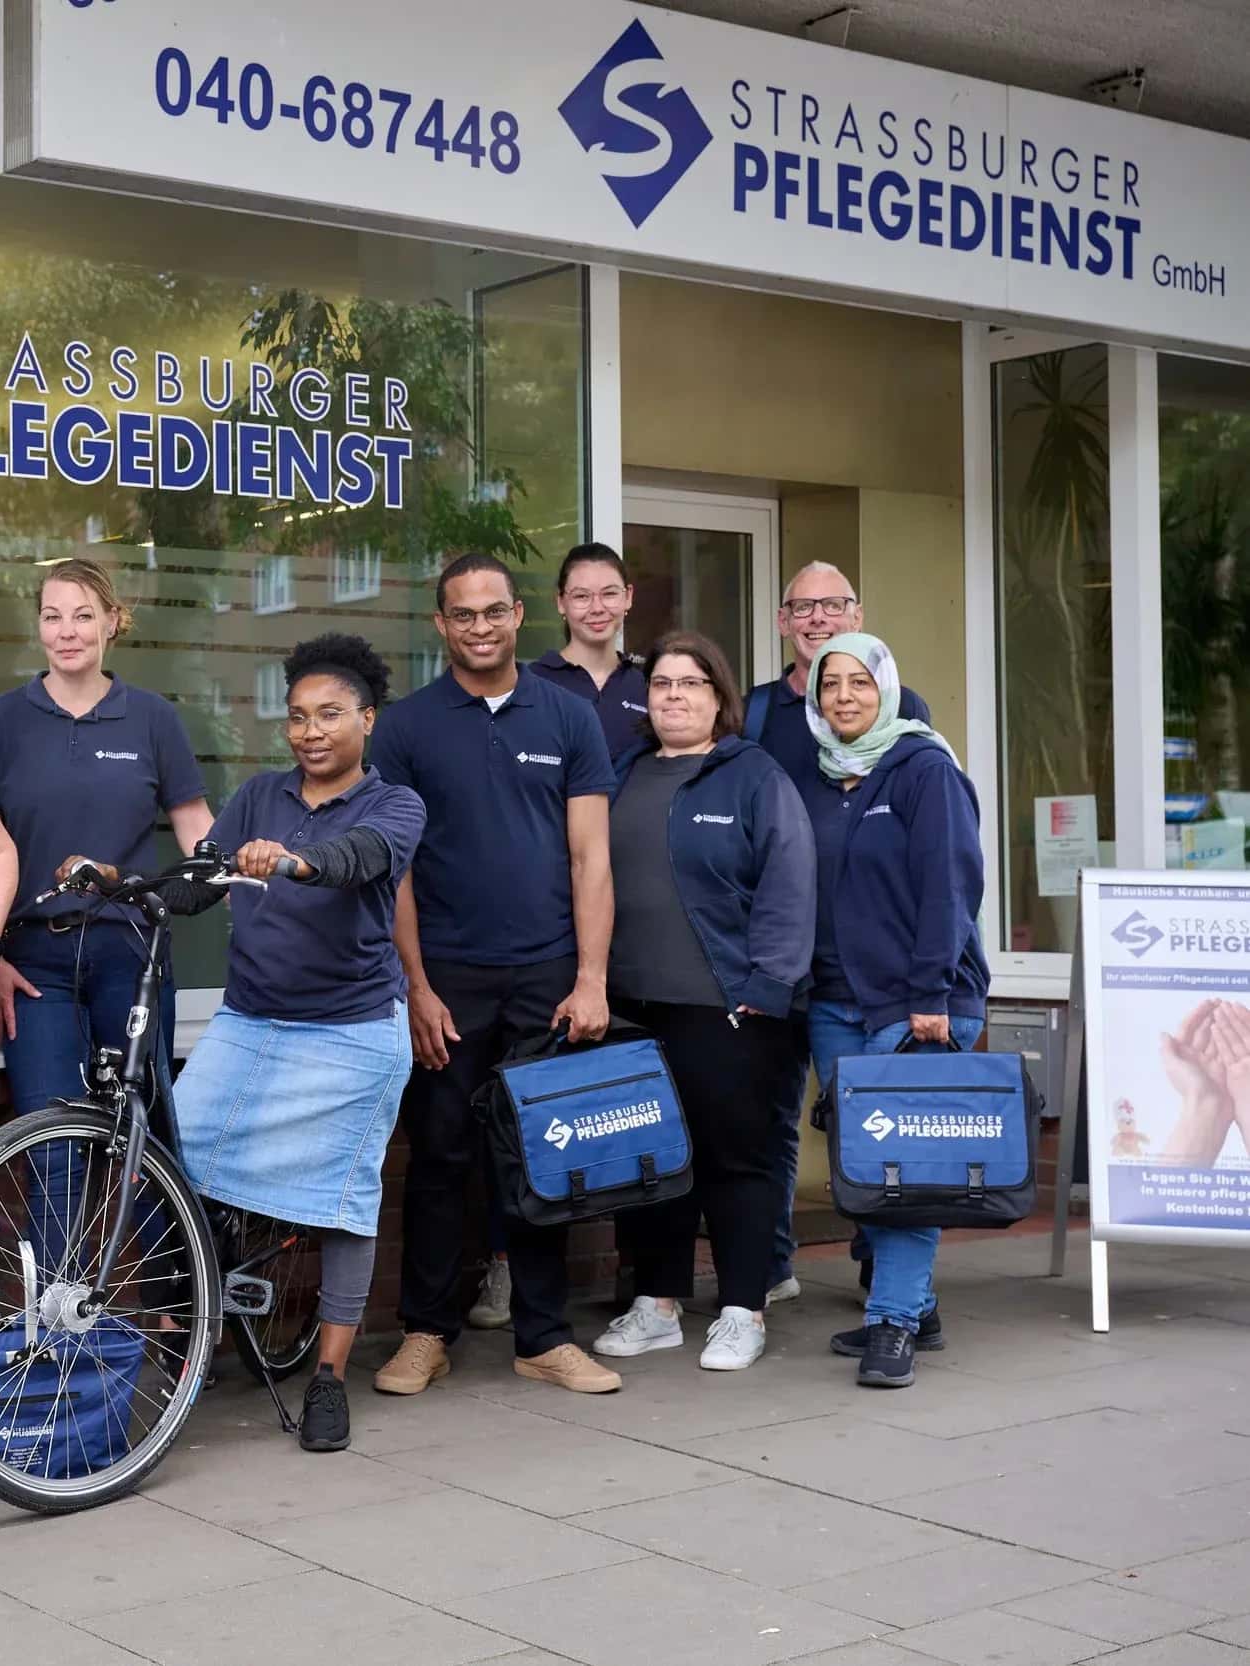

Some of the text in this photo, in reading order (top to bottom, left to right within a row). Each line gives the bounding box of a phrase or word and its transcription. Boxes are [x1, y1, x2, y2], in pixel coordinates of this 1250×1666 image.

[154, 47, 522, 174] 040-687448
[730, 79, 1141, 207] STRASSBURGER
[733, 142, 1225, 297] PFLEGEDIENST GmbH
[573, 1100, 660, 1129] STRASSBURGER
[576, 1110, 662, 1141] PFLEGEDIENST
[897, 1115, 1002, 1125] STRASSBURGER
[899, 1124, 1003, 1138] PFLEGEDIENST
[1141, 1172, 1185, 1185] Legen
[1216, 1174, 1237, 1186] Ihr
